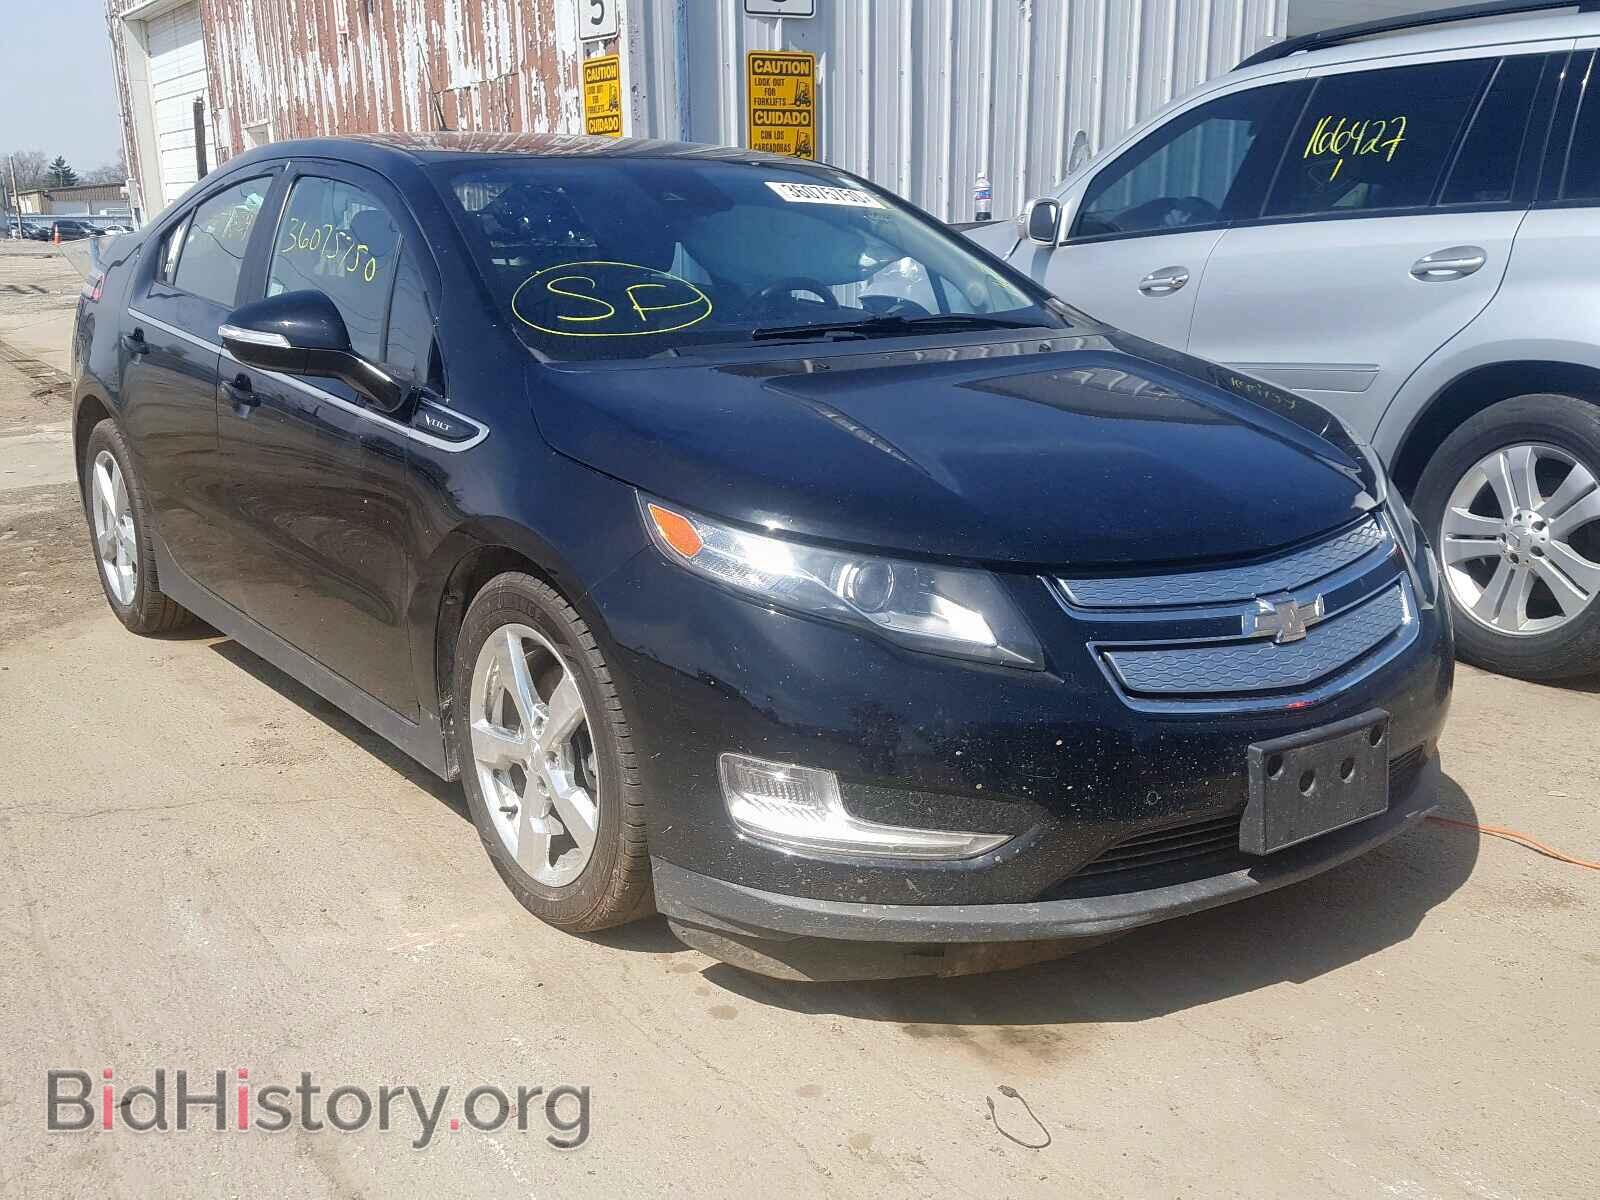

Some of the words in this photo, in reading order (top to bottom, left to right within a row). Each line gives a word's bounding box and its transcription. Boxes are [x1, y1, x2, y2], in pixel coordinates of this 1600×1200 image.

[586, 64, 617, 82] CAUTION
[753, 59, 810, 75] CAUTION
[754, 78, 770, 87] LOOK
[772, 78, 785, 87] OUT
[763, 87, 776, 97] FOR
[753, 97, 787, 106] FORKLIFTS
[587, 116, 619, 134] CUIDADO
[754, 110, 810, 126] CUIDADO
[281, 217, 376, 282] 36075750
[425, 413, 449, 431] VOLT
